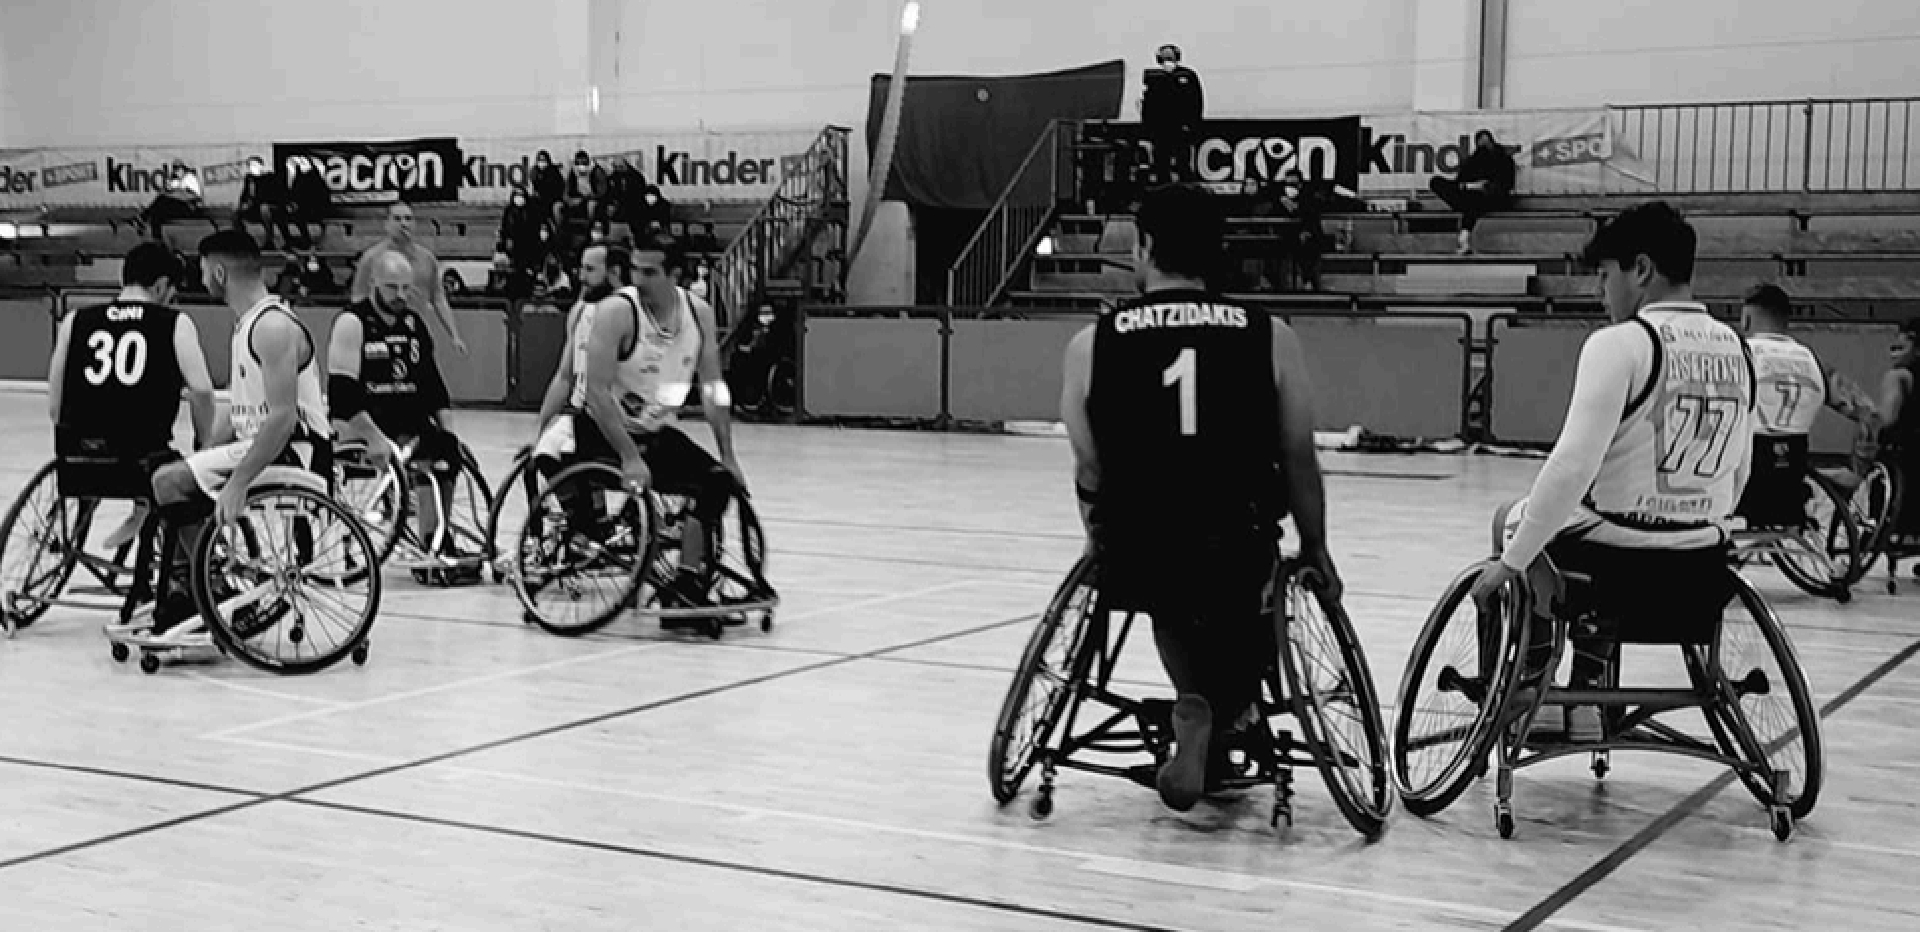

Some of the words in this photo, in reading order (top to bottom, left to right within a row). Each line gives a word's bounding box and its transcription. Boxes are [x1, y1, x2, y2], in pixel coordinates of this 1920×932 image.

[458, 149, 530, 188] Kind
[656, 144, 774, 185] Kinder
[1360, 127, 1471, 173] Kind
[106, 305, 144, 321] CINI
[1115, 303, 1248, 333] CHATZIDAKIS
[83, 330, 148, 386] 30
[1162, 347, 1197, 436] 1
[1774, 380, 1801, 427] 7
[1657, 394, 1739, 478] 77
